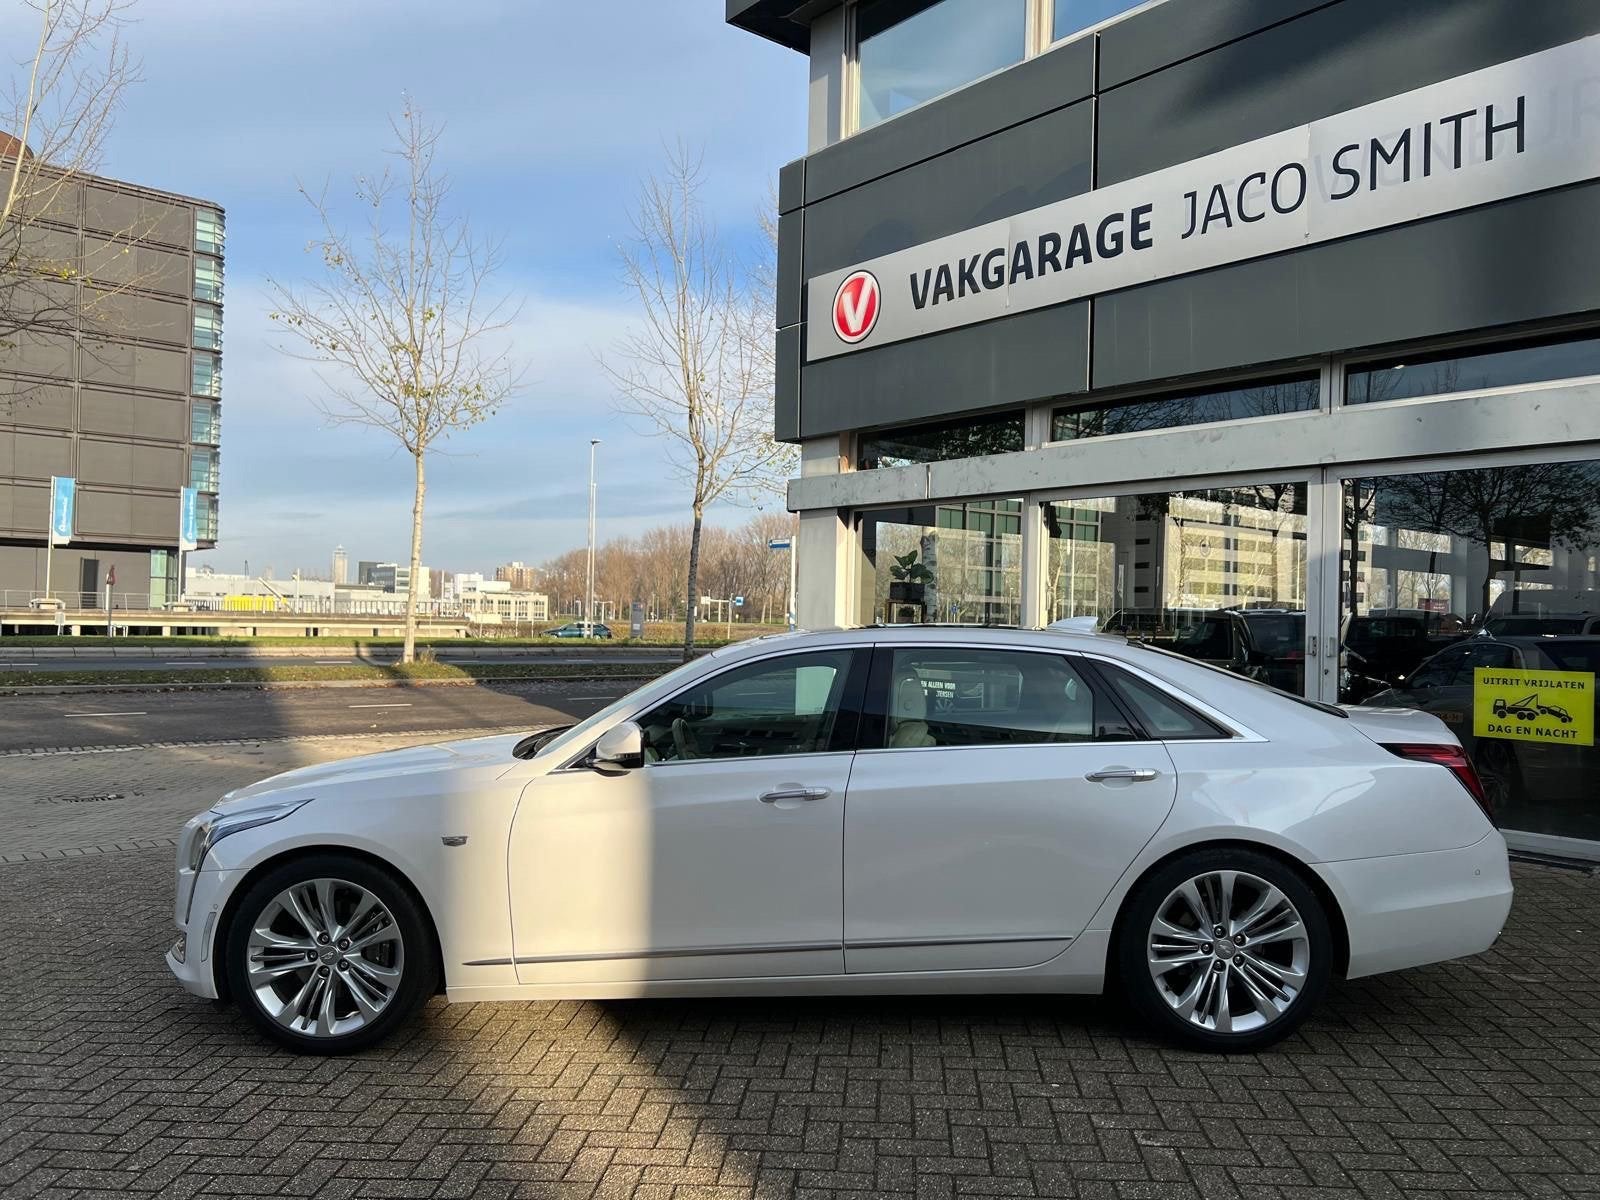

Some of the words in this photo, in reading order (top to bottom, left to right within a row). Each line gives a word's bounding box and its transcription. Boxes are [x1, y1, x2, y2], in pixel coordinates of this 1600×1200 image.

[909, 203, 1153, 310] VAKGARAGE
[1181, 162, 1307, 240] JACO
[1331, 95, 1525, 201] SMITH
[1483, 677, 1520, 686] UITRIT
[1523, 679, 1585, 689] VRIJLATEN
[1487, 724, 1512, 733] DAG
[1516, 726, 1531, 735] EN
[1536, 728, 1578, 738] NACHT
